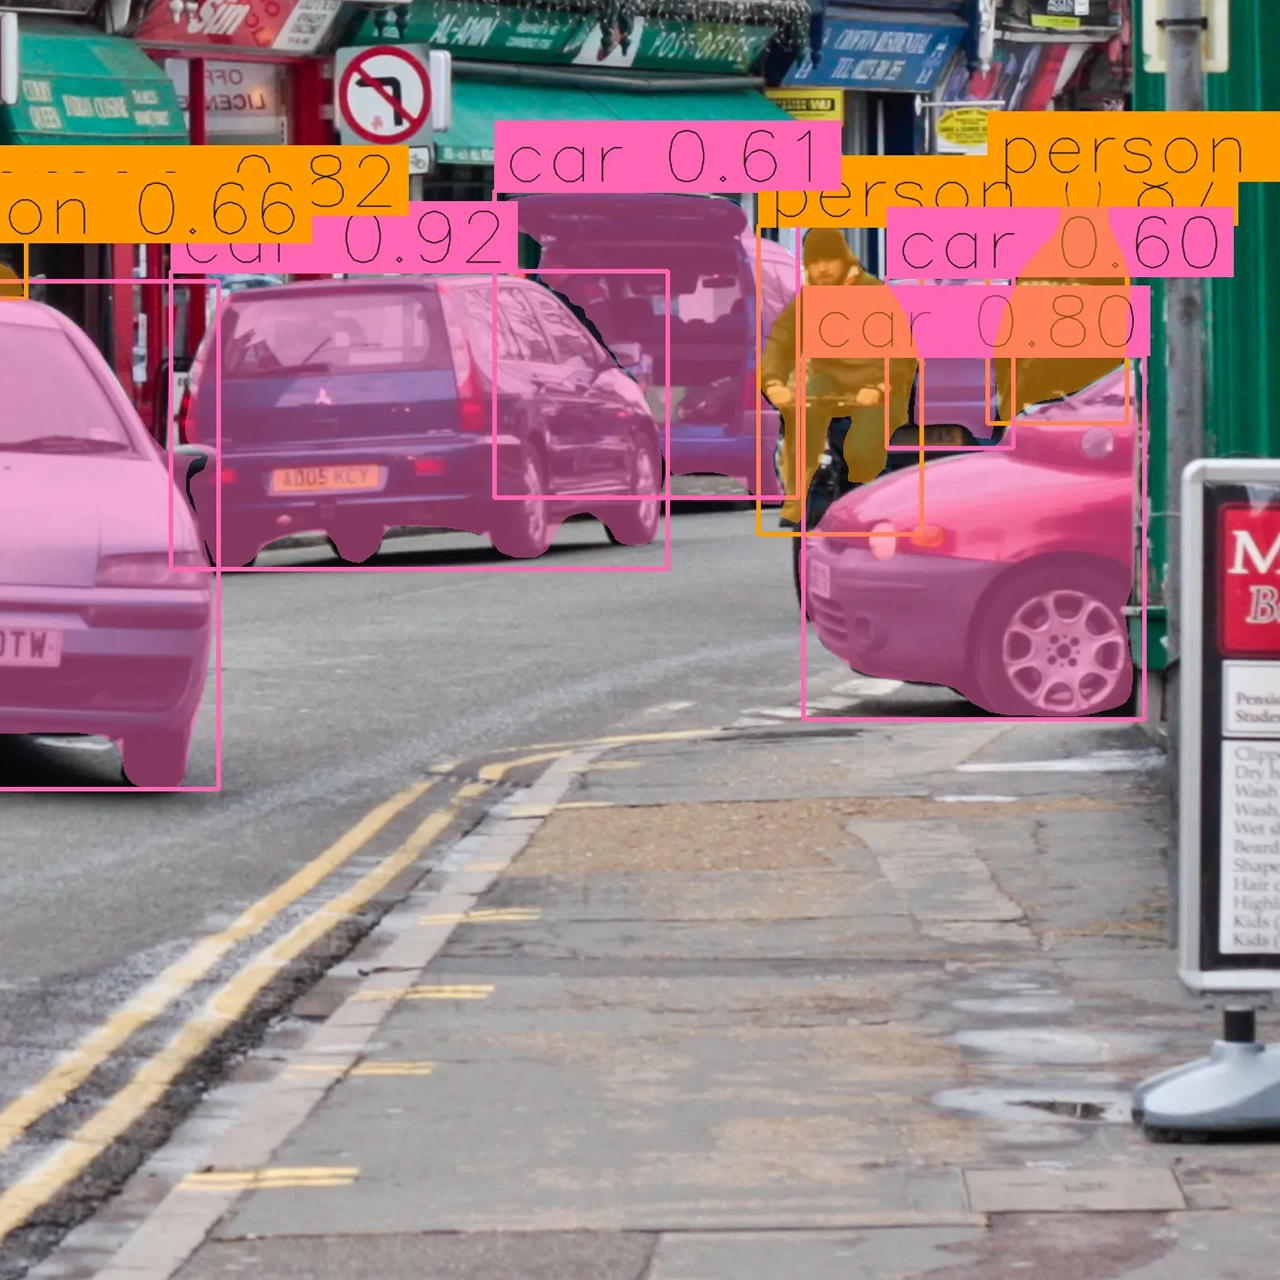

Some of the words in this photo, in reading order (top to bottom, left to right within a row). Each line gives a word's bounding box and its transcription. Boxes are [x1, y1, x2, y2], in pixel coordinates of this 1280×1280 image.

[647, 31, 691, 58] POST
[695, 32, 756, 62] OFFICE
[1235, 765, 1263, 785] Dry
[1234, 783, 1278, 798] Wash
[1234, 821, 1265, 836] Wet
[1233, 876, 1269, 892] Hair
[1233, 914, 1269, 929] Kids
[1233, 932, 1269, 947] Kids
